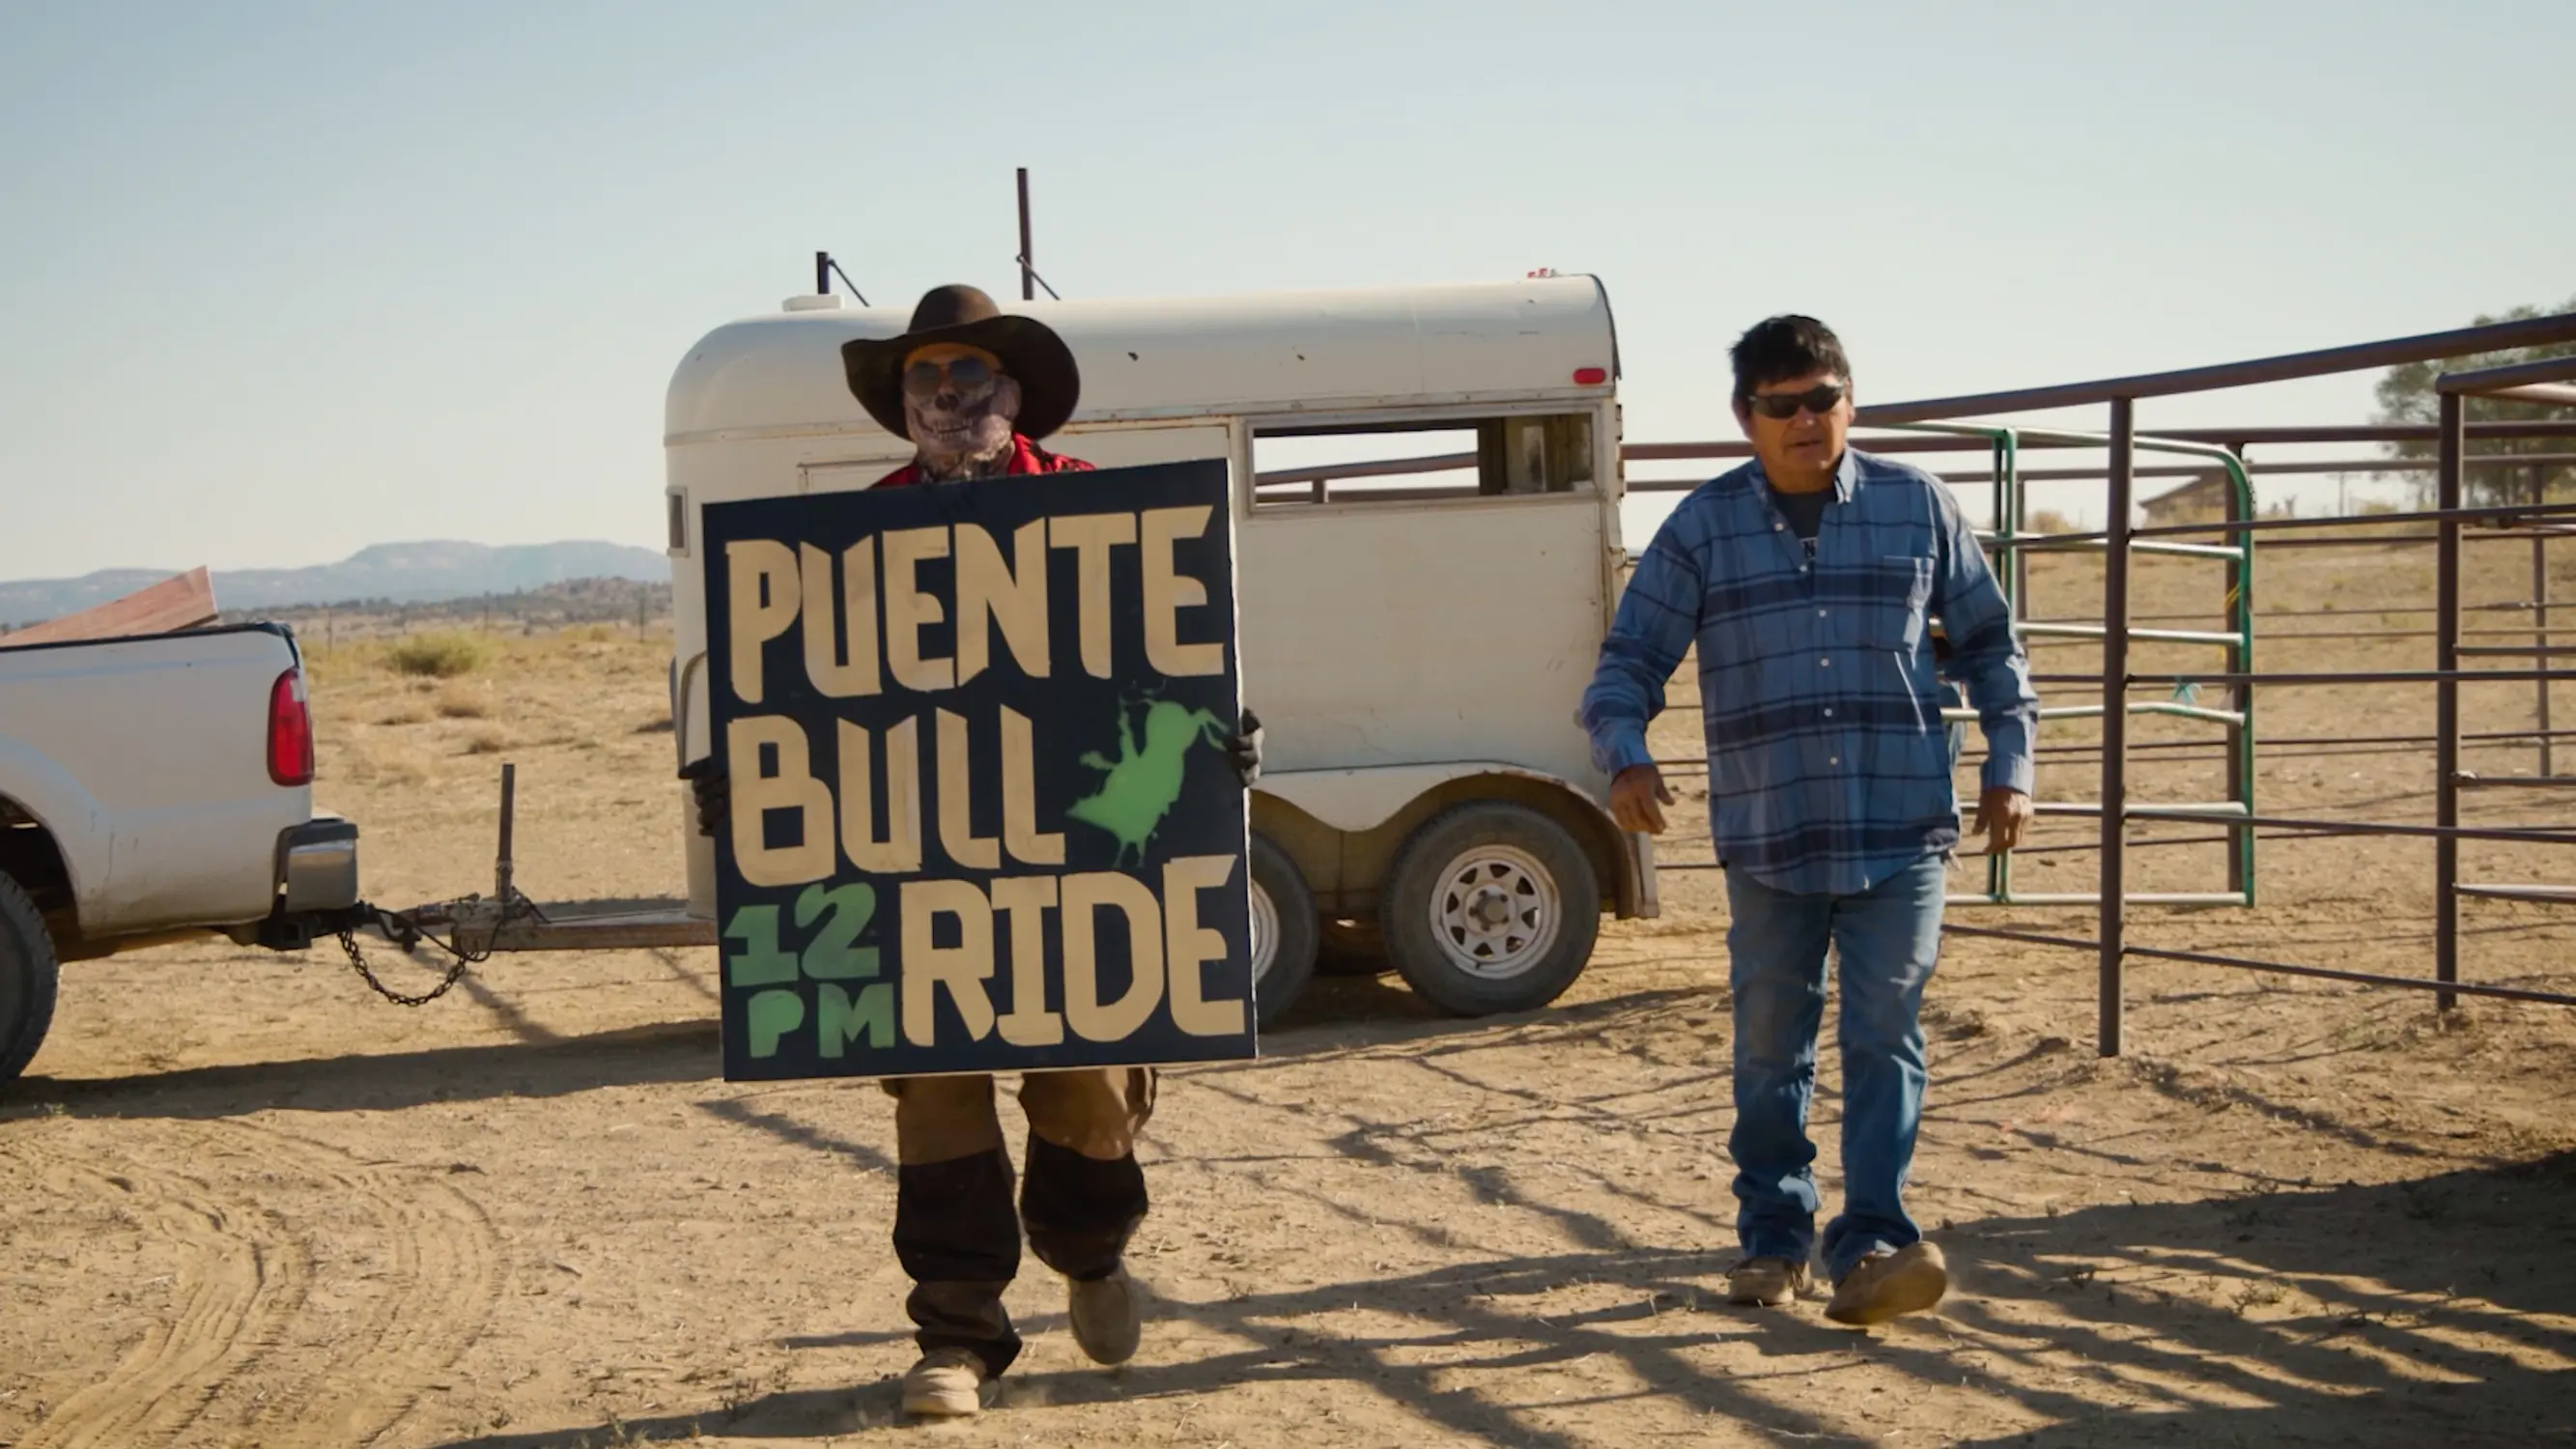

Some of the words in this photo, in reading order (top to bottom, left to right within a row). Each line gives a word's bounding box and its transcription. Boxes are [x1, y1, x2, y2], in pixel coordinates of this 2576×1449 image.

[725, 505, 1225, 704] PUENTE
[726, 703, 1065, 887] BULL
[723, 883, 880, 987] 12
[748, 982, 895, 1059] PM
[899, 854, 1246, 1047] RIDE
